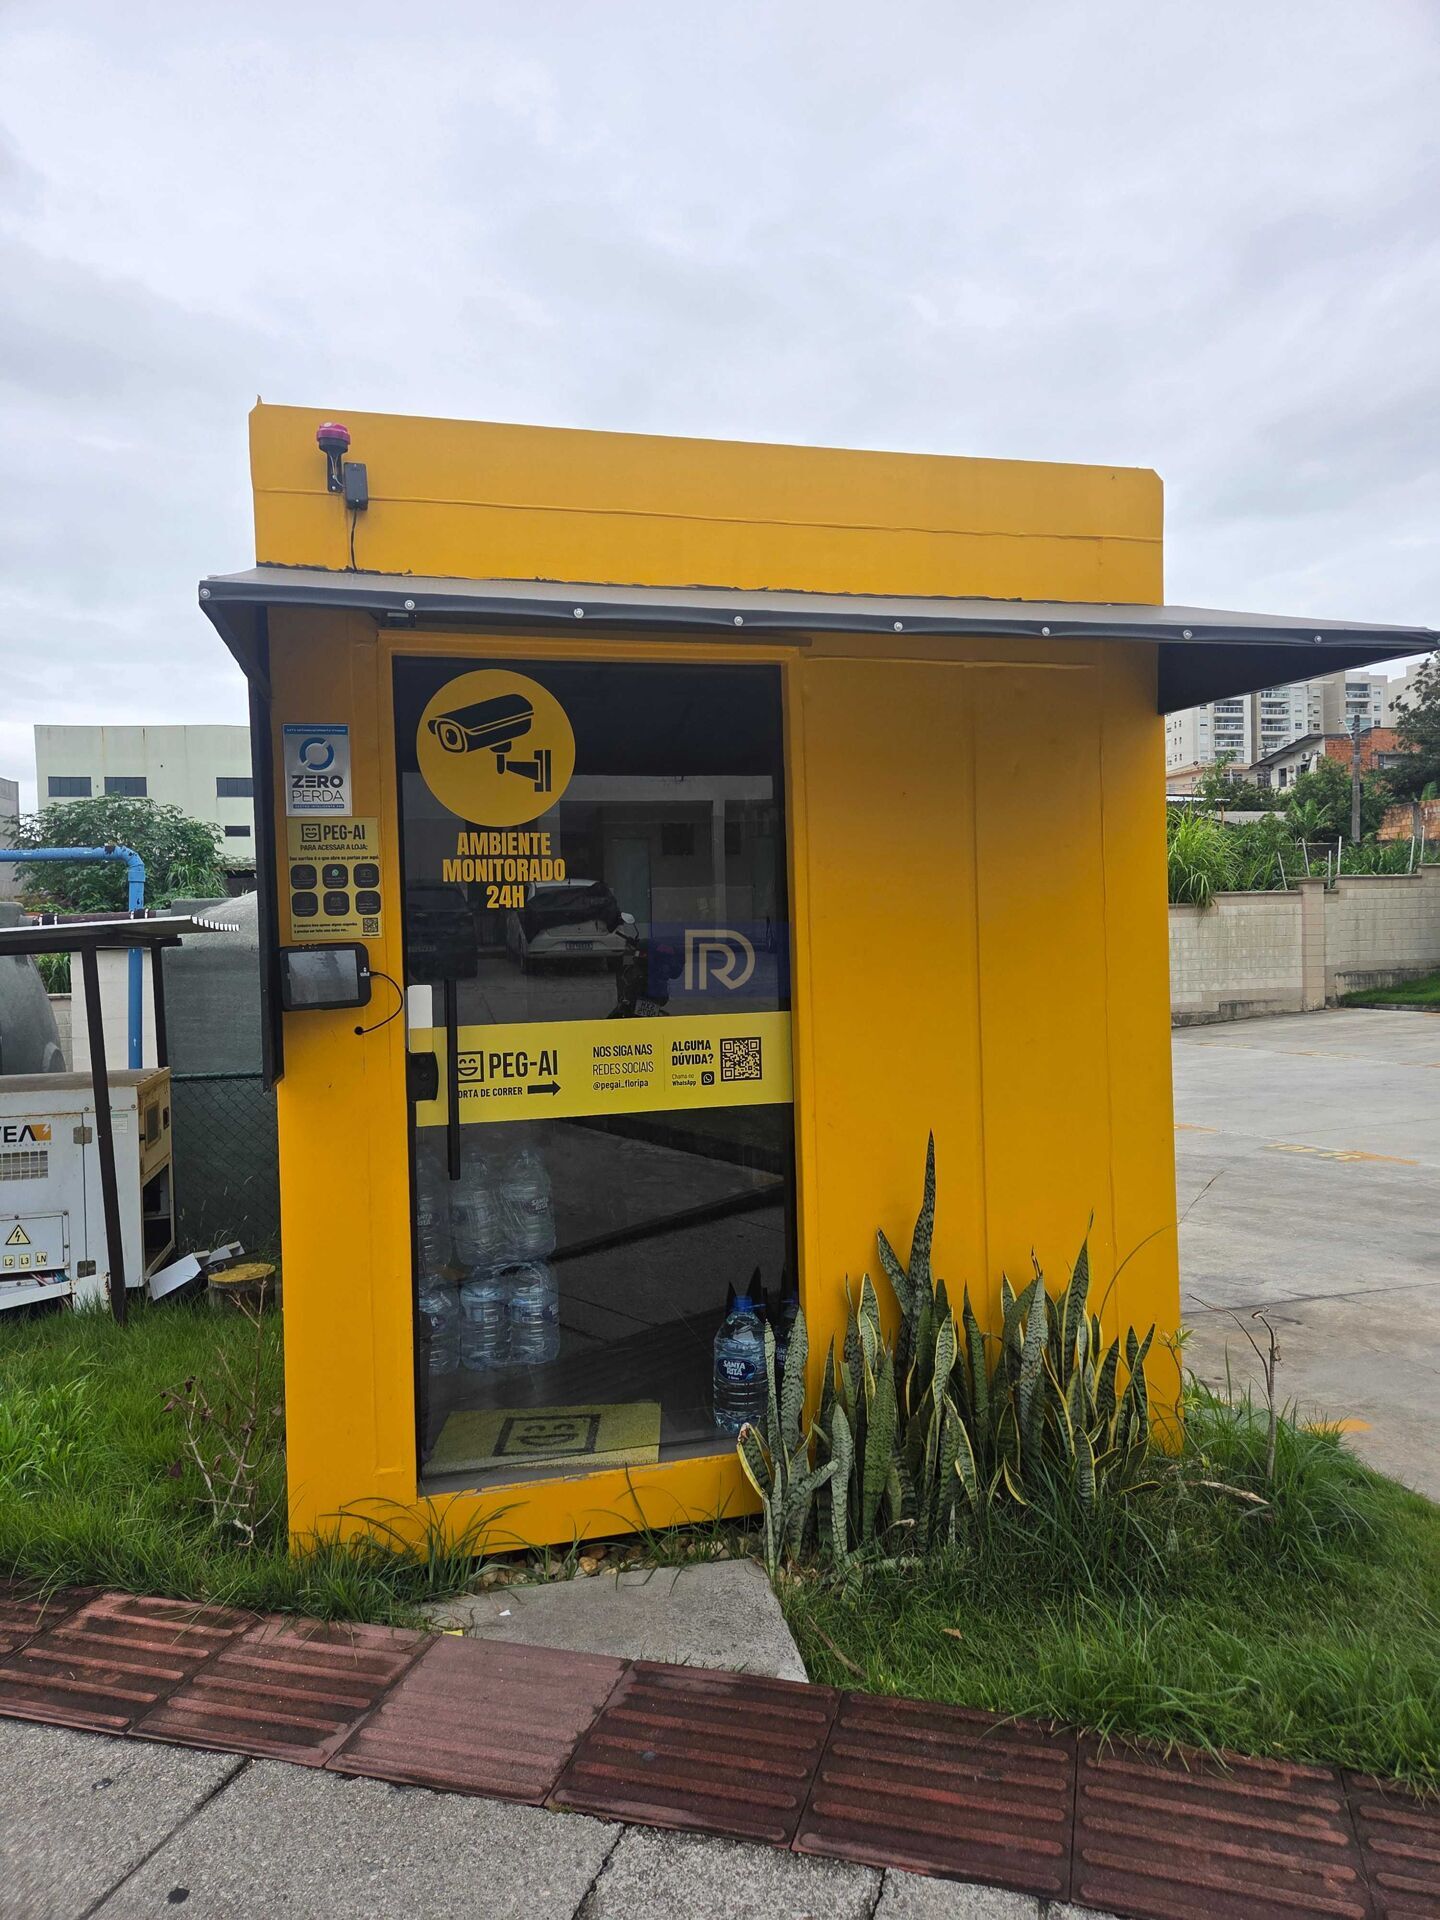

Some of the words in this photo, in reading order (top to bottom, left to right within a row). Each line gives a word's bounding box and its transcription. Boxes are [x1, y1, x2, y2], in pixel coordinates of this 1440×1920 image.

[292, 775, 344, 788] ZERO
[292, 790, 344, 802] PERDA
[324, 825, 365, 840] PEG-AI
[457, 832, 551, 855] AMBIENTE
[443, 859, 565, 882] MONITORADO
[486, 885, 525, 908] 24H
[593, 1046, 611, 1058] NOS
[613, 1045, 633, 1056] SIGA
[634, 1044, 653, 1055] NAS
[672, 1040, 711, 1052] ALGUMA
[489, 1050, 558, 1078] PEG-AI
[672, 1053, 714, 1066] DÚVIDA?
[593, 1063, 620, 1076] REDES
[622, 1061, 654, 1074] SOCIAIS
[593, 1079, 649, 1090] @pegai_floripa
[457, 1089, 479, 1099] ORTA
[481, 1088, 491, 1097] DE
[492, 1087, 523, 1097] CORRER
[4, 1258, 14, 1266] L2
[20, 1257, 29, 1265] L3
[37, 1255, 47, 1263] LN
[723, 1360, 746, 1370] SANTA
[726, 1368, 743, 1376] RITA
